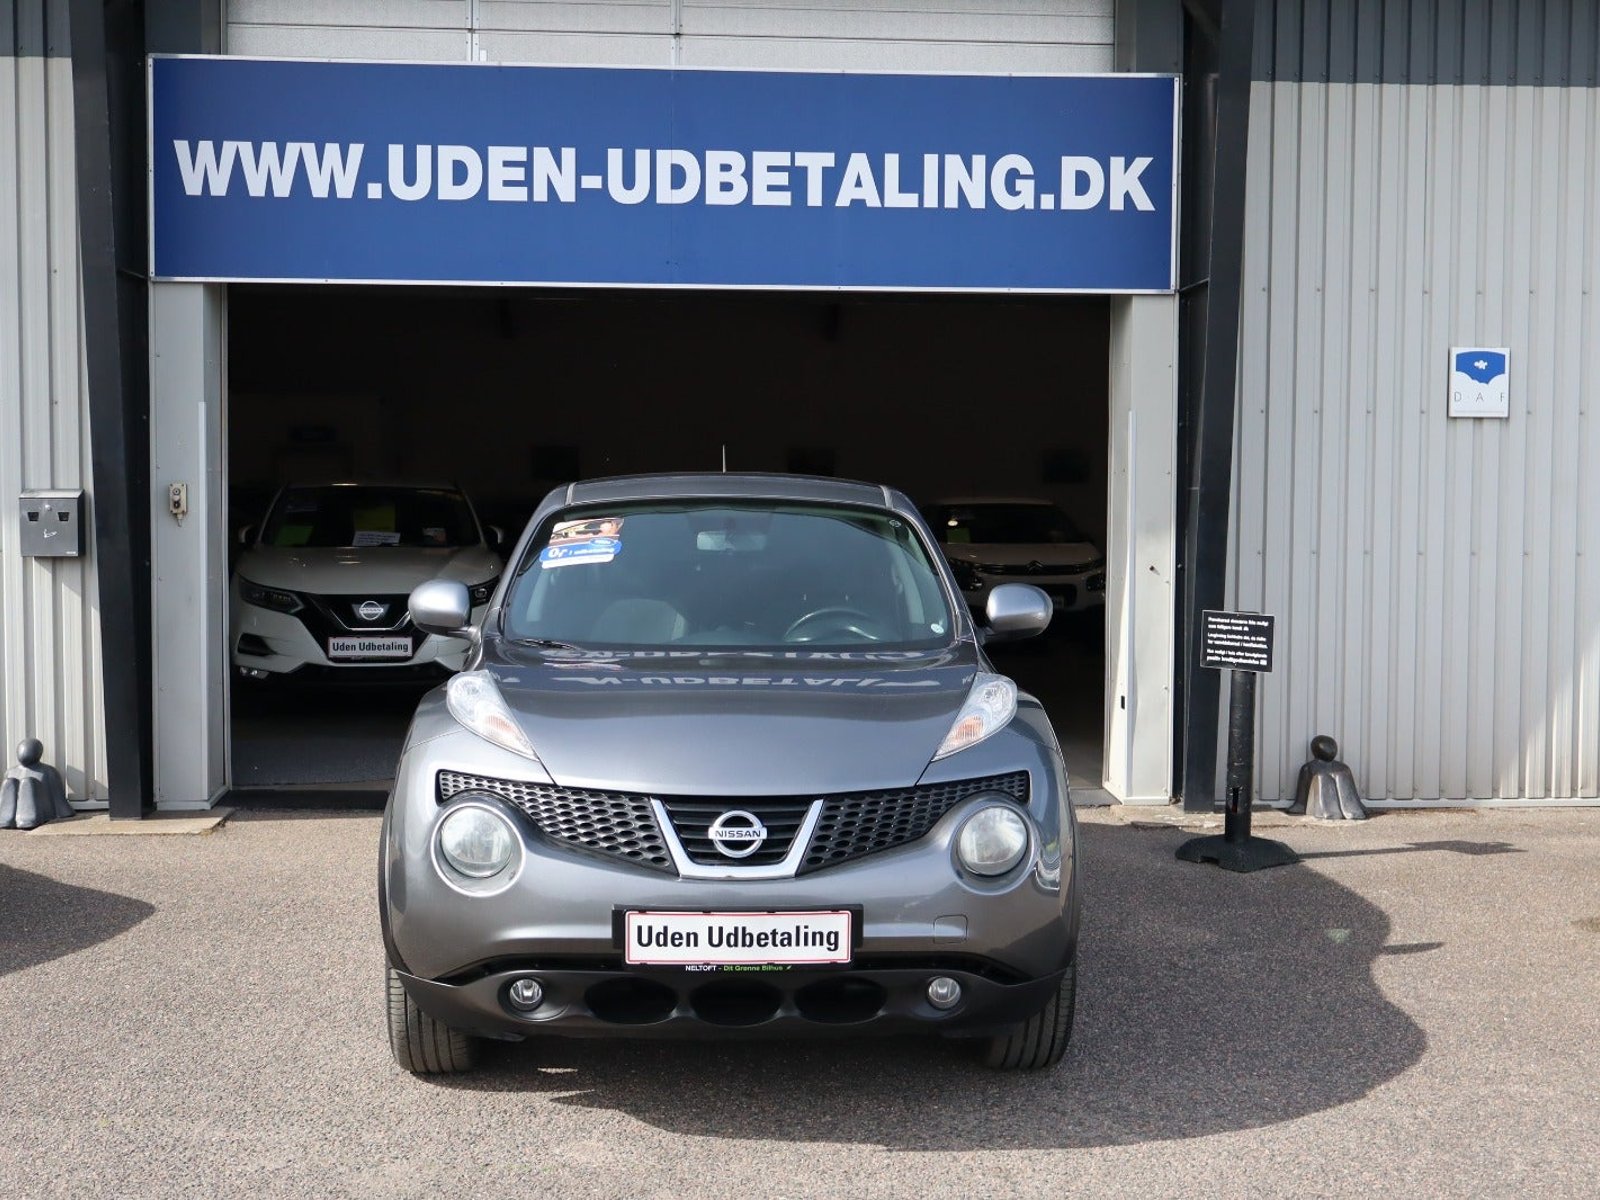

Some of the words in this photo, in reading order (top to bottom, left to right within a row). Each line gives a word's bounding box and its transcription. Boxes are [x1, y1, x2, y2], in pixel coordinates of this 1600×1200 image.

[173, 139, 1156, 212] WWW.UDEN-UDBETALING.DK
[332, 642, 357, 651] Uden
[358, 642, 409, 652] Udbetaling
[714, 830, 761, 838] NISSAN
[636, 925, 699, 948] Uden
[707, 925, 840, 951] Udbetaling
